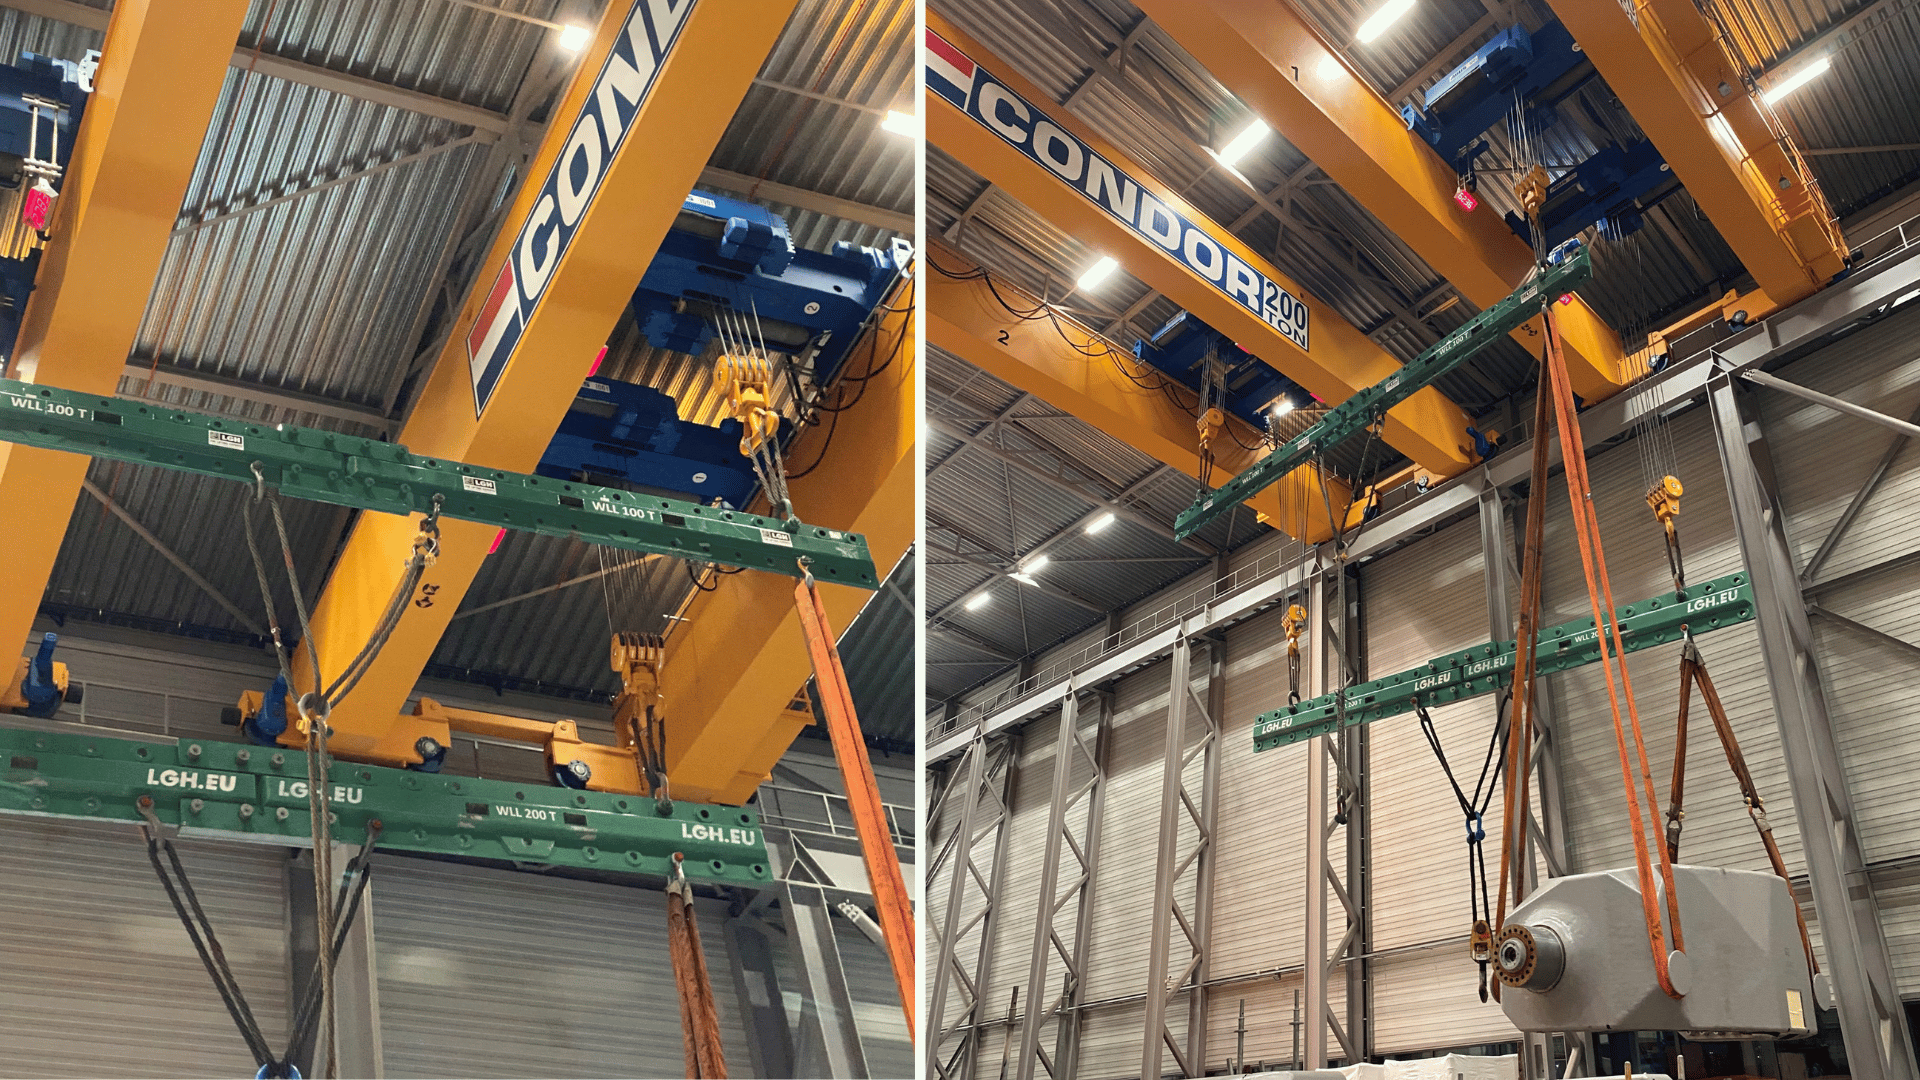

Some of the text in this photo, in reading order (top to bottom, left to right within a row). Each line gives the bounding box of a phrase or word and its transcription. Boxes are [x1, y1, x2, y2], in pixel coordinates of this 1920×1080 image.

[1291, 65, 1299, 82] 1
[977, 81, 1261, 313] CONDOR
[1265, 281, 1306, 331] 200
[997, 329, 1009, 346] 2
[1265, 307, 1306, 348] TON
[11, 396, 88, 419] WLL 100 T
[474, 479, 494, 488] LGH
[592, 500, 656, 521] WLL 100 T
[1687, 589, 1738, 614] LGH.EU
[1574, 633, 1590, 643] WLL
[1604, 627, 1610, 635] T
[1468, 655, 1508, 676] LGH.EU
[1414, 672, 1451, 692] LGH.EU
[1261, 717, 1293, 735] LGH.EU
[147, 768, 237, 792] LGH.EU
[278, 780, 363, 804] LG.EU
[495, 805, 557, 822] WLL 200 T
[681, 822, 756, 846] LGH.EU
